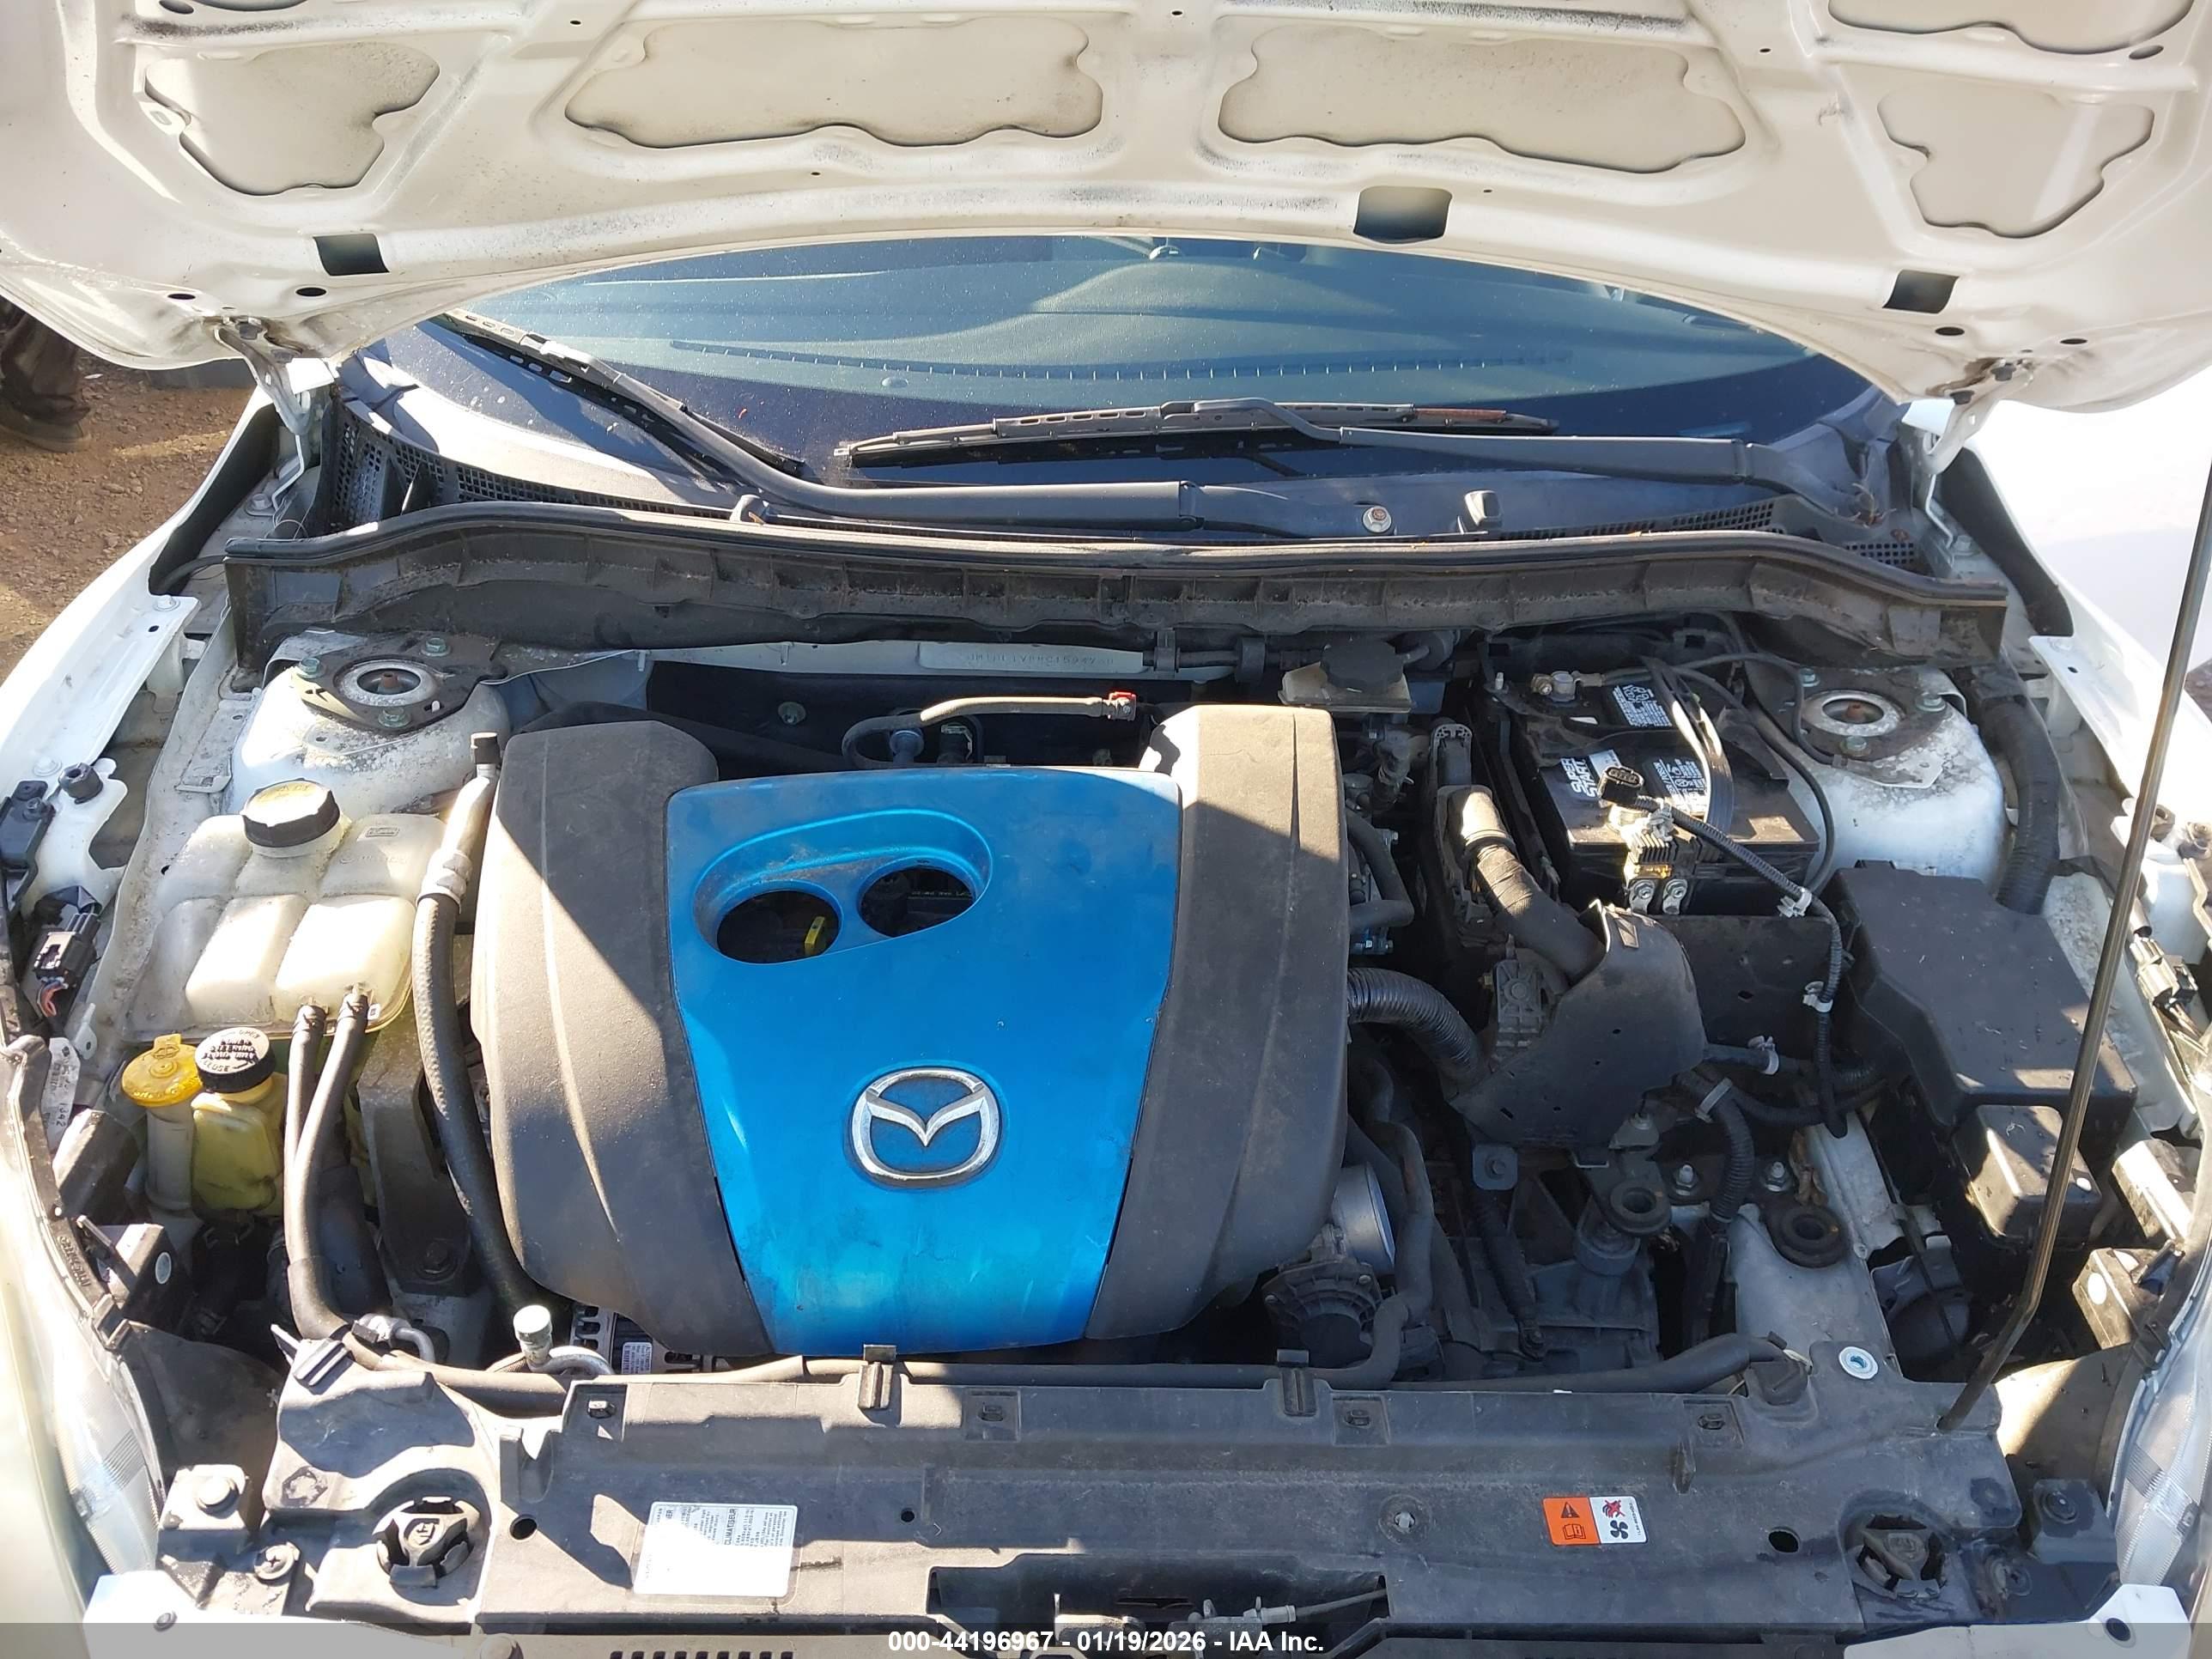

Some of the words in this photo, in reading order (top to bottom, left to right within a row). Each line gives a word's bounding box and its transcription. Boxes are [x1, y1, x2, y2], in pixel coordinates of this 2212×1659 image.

[1560, 757, 1583, 793] SUPER
[1575, 758, 1598, 797] START
[203, 1060, 230, 1072] CLOSE
[724, 1508, 738, 1546] CLIMATISEUR
